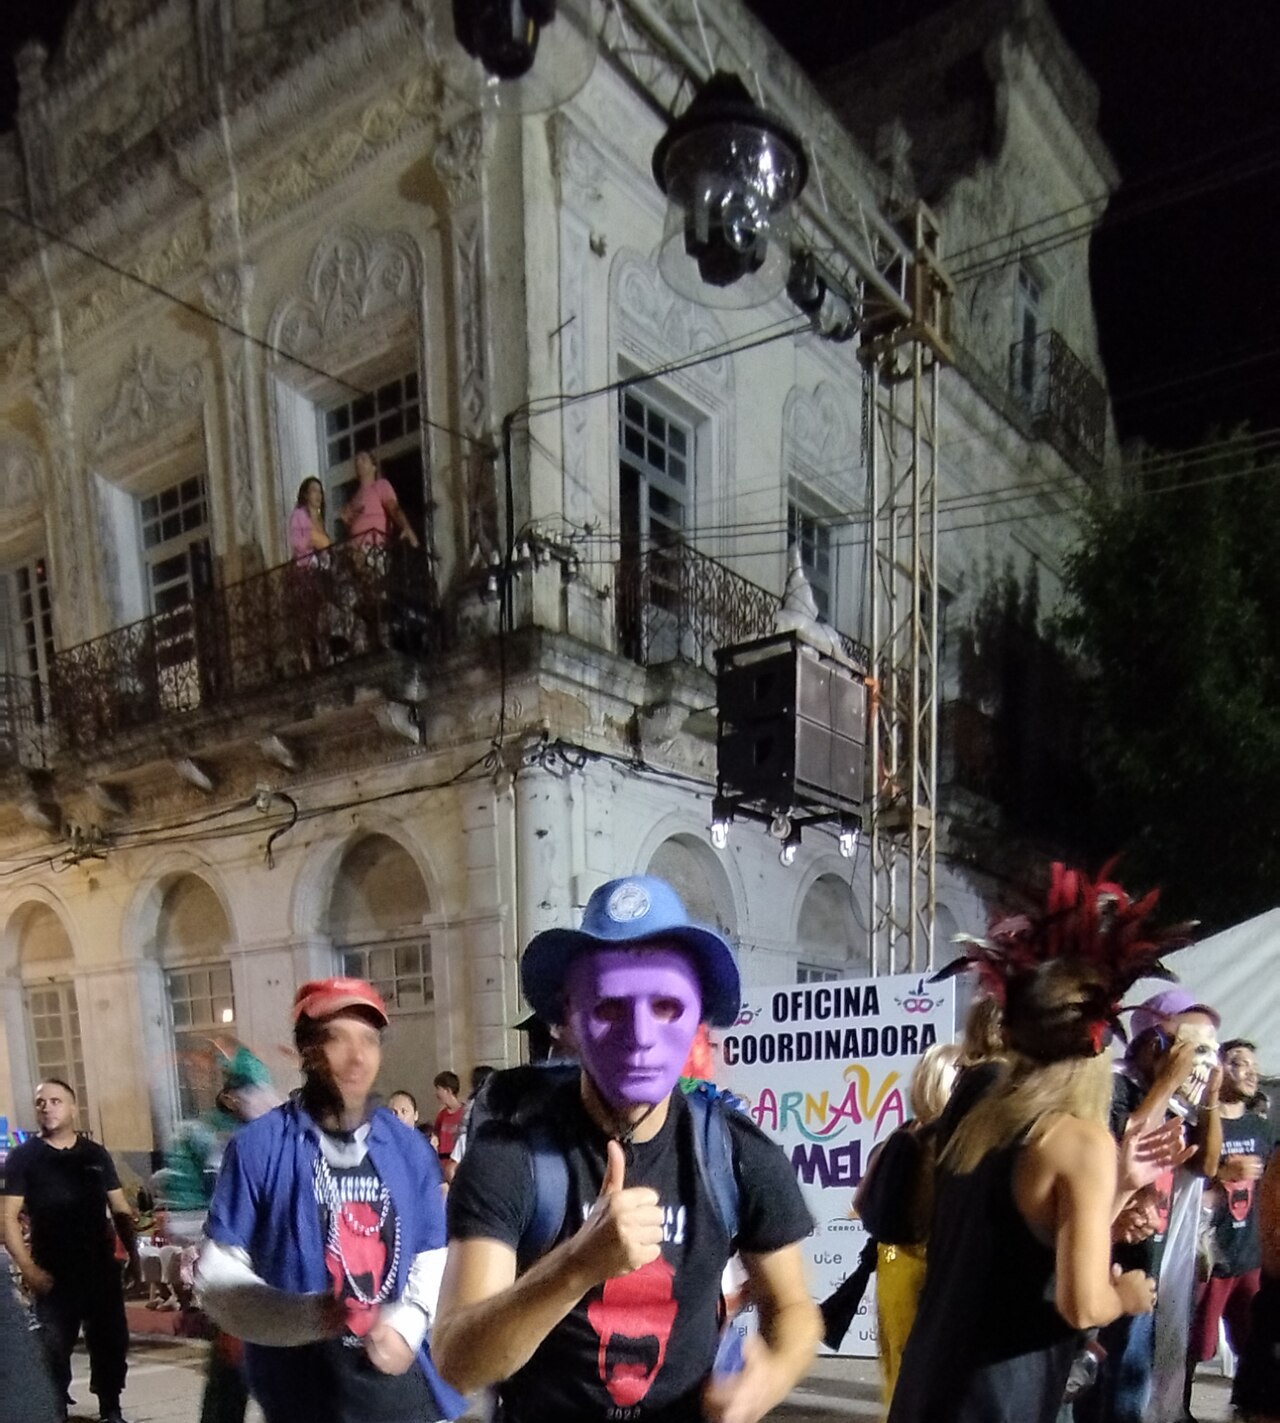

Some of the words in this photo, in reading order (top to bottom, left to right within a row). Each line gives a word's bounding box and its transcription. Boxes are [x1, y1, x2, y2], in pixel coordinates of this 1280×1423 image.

[772, 985, 880, 1023] OFICINA
[723, 1023, 937, 1066] COORDINADORA
[750, 1064, 913, 1142] ARNAVA
[791, 1139, 864, 1189] MEL
